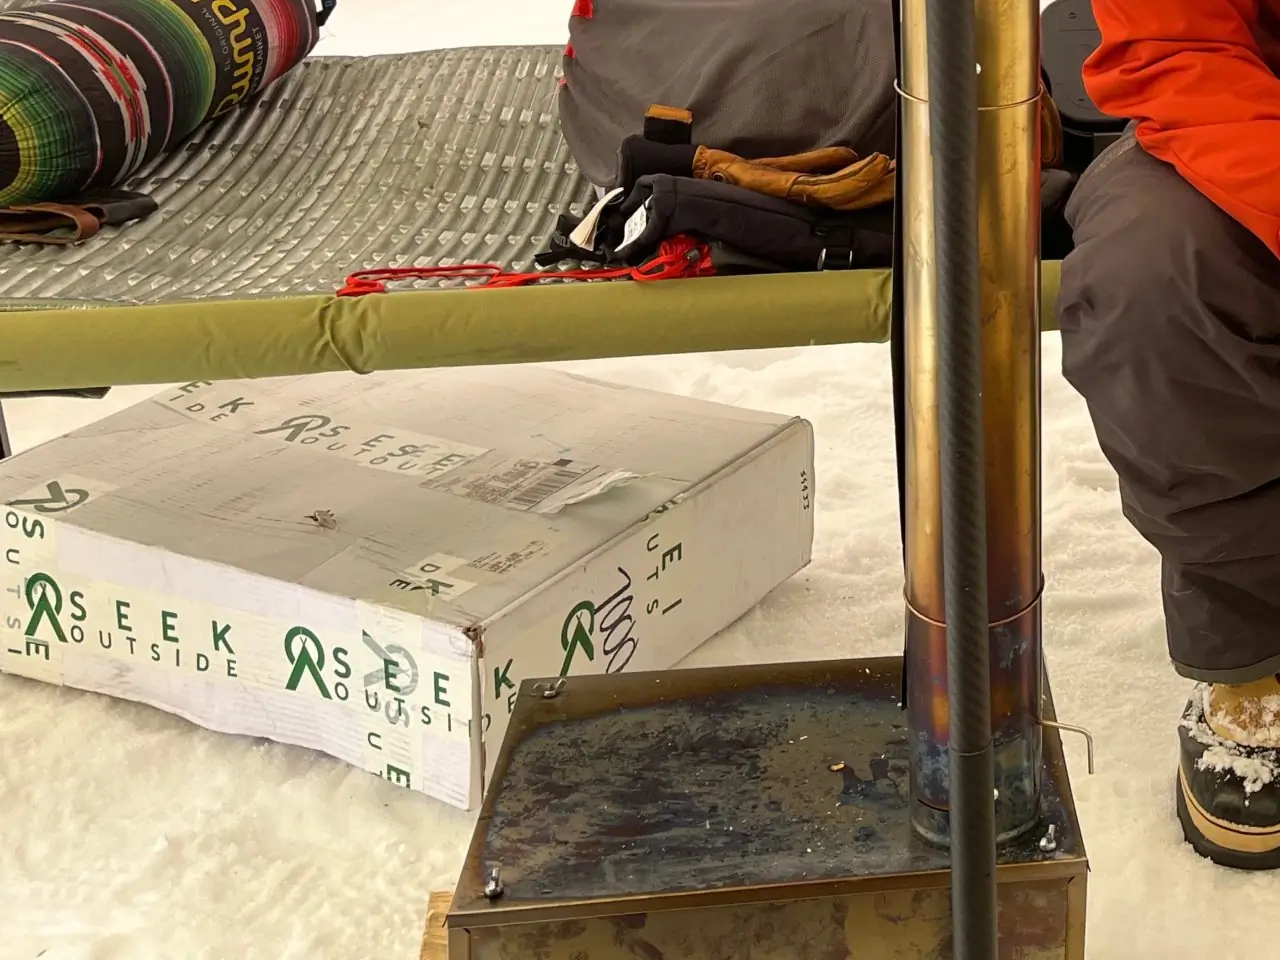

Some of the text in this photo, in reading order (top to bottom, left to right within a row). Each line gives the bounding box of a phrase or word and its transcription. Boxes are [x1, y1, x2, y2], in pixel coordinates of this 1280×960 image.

[252, 26, 265, 76] BLANKET
[70, 590, 236, 655] SEEK
[70, 624, 238, 678] OUTSIDE
[333, 646, 516, 708] SEEK
